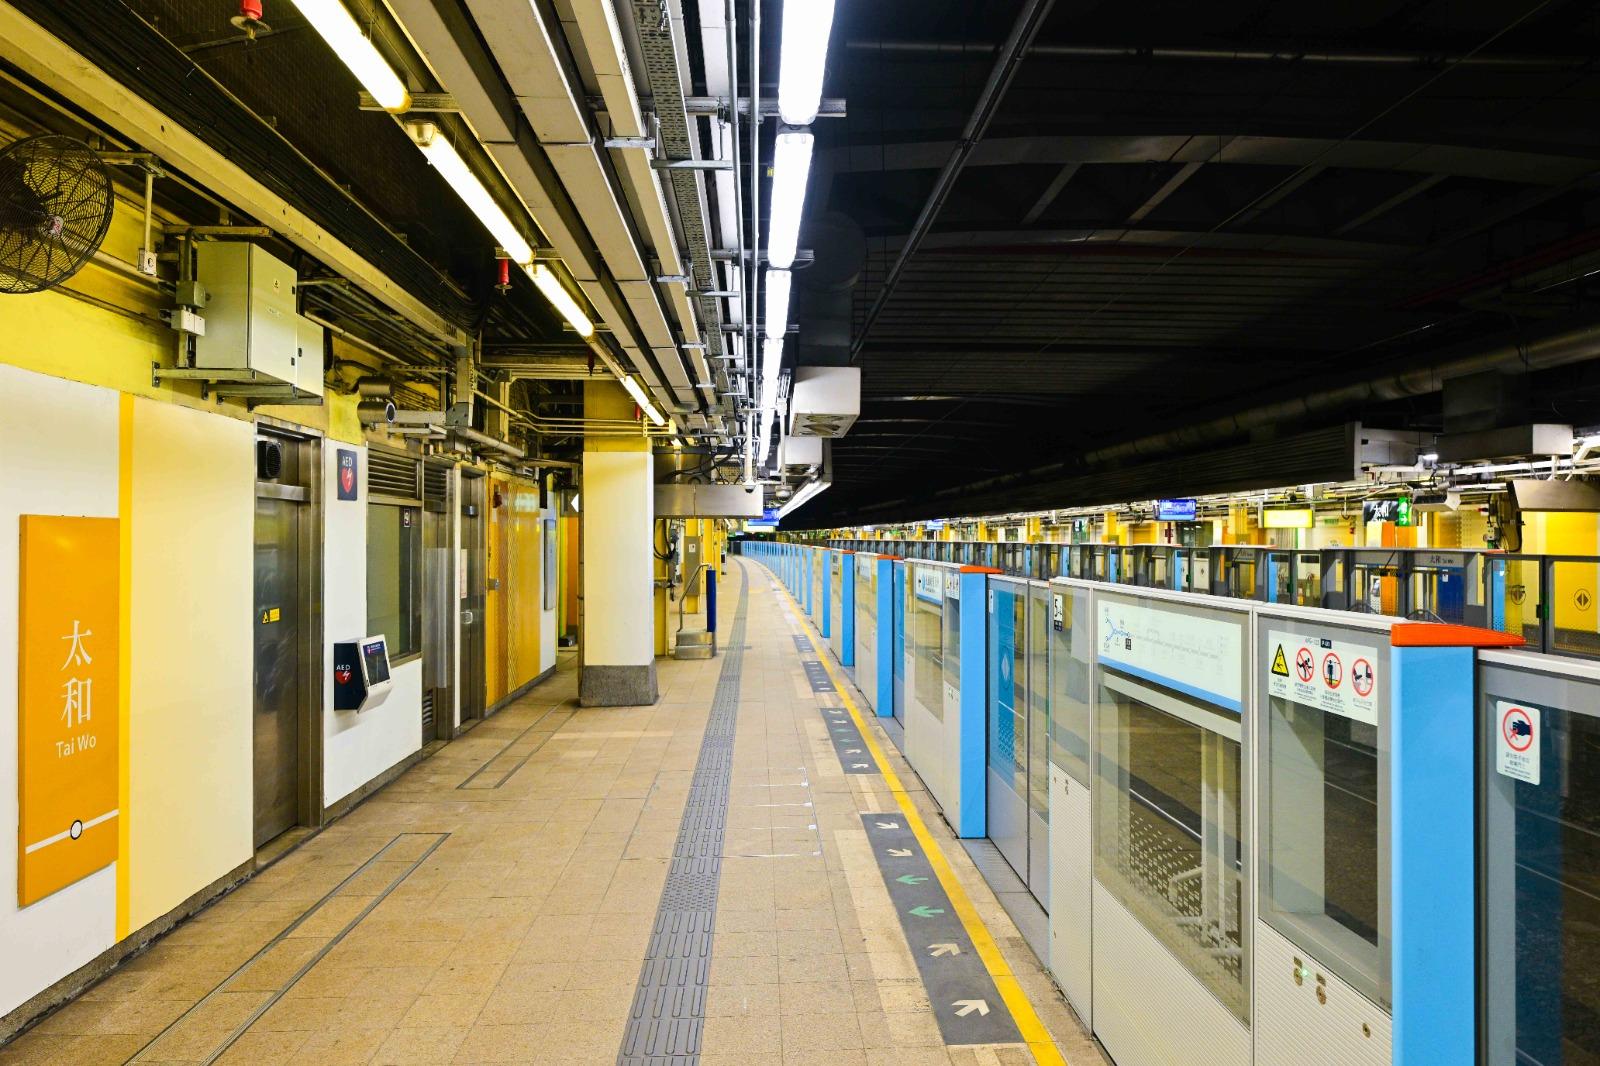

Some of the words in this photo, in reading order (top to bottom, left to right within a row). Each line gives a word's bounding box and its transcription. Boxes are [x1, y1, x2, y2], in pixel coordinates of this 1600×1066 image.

[342, 456, 353, 467] AED
[61, 619, 93, 728] 太和
[56, 737, 74, 758] Tai
[77, 734, 96, 753] Wo
